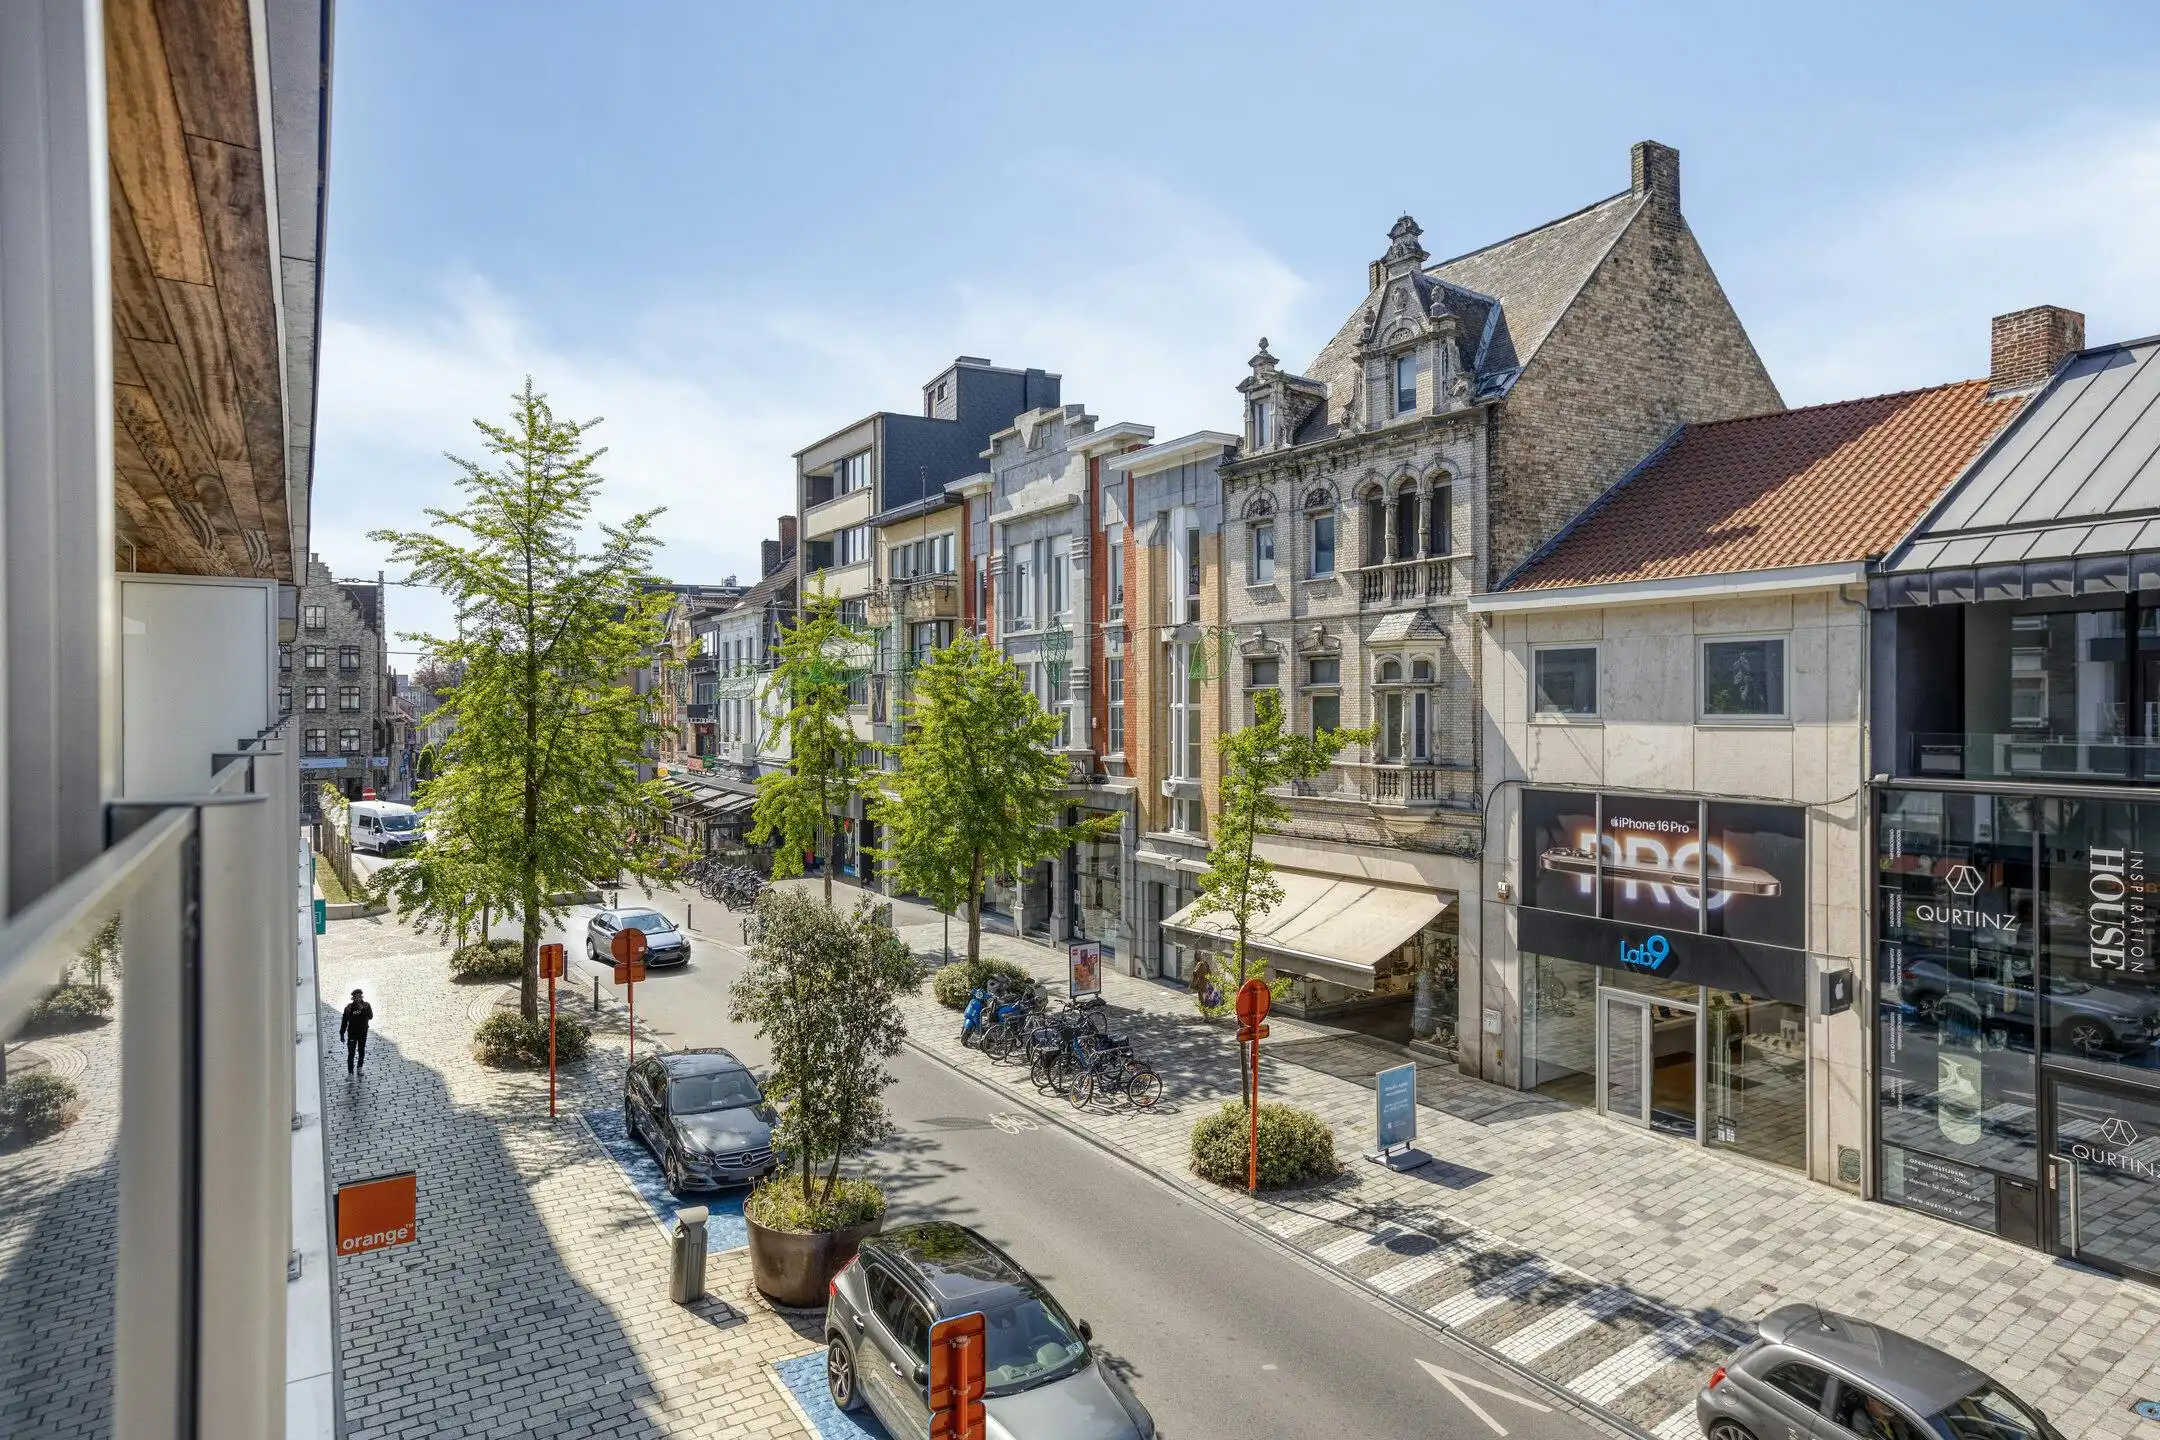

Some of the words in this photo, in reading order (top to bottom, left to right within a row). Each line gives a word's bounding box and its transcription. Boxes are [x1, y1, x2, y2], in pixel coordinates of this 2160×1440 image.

[1619, 816, 1656, 830] iPhone
[1656, 820, 1669, 831] 16
[1670, 821, 1690, 834] Pro
[1580, 832, 1733, 909] PRO
[1916, 904, 2017, 932] QURTINZ
[2089, 845, 2126, 971] HOUSE
[2130, 850, 2144, 973] INSPIRATION
[1619, 935, 1670, 970] Lab9
[2072, 1144, 2160, 1179] QURTIN
[342, 1227, 408, 1250] orange
